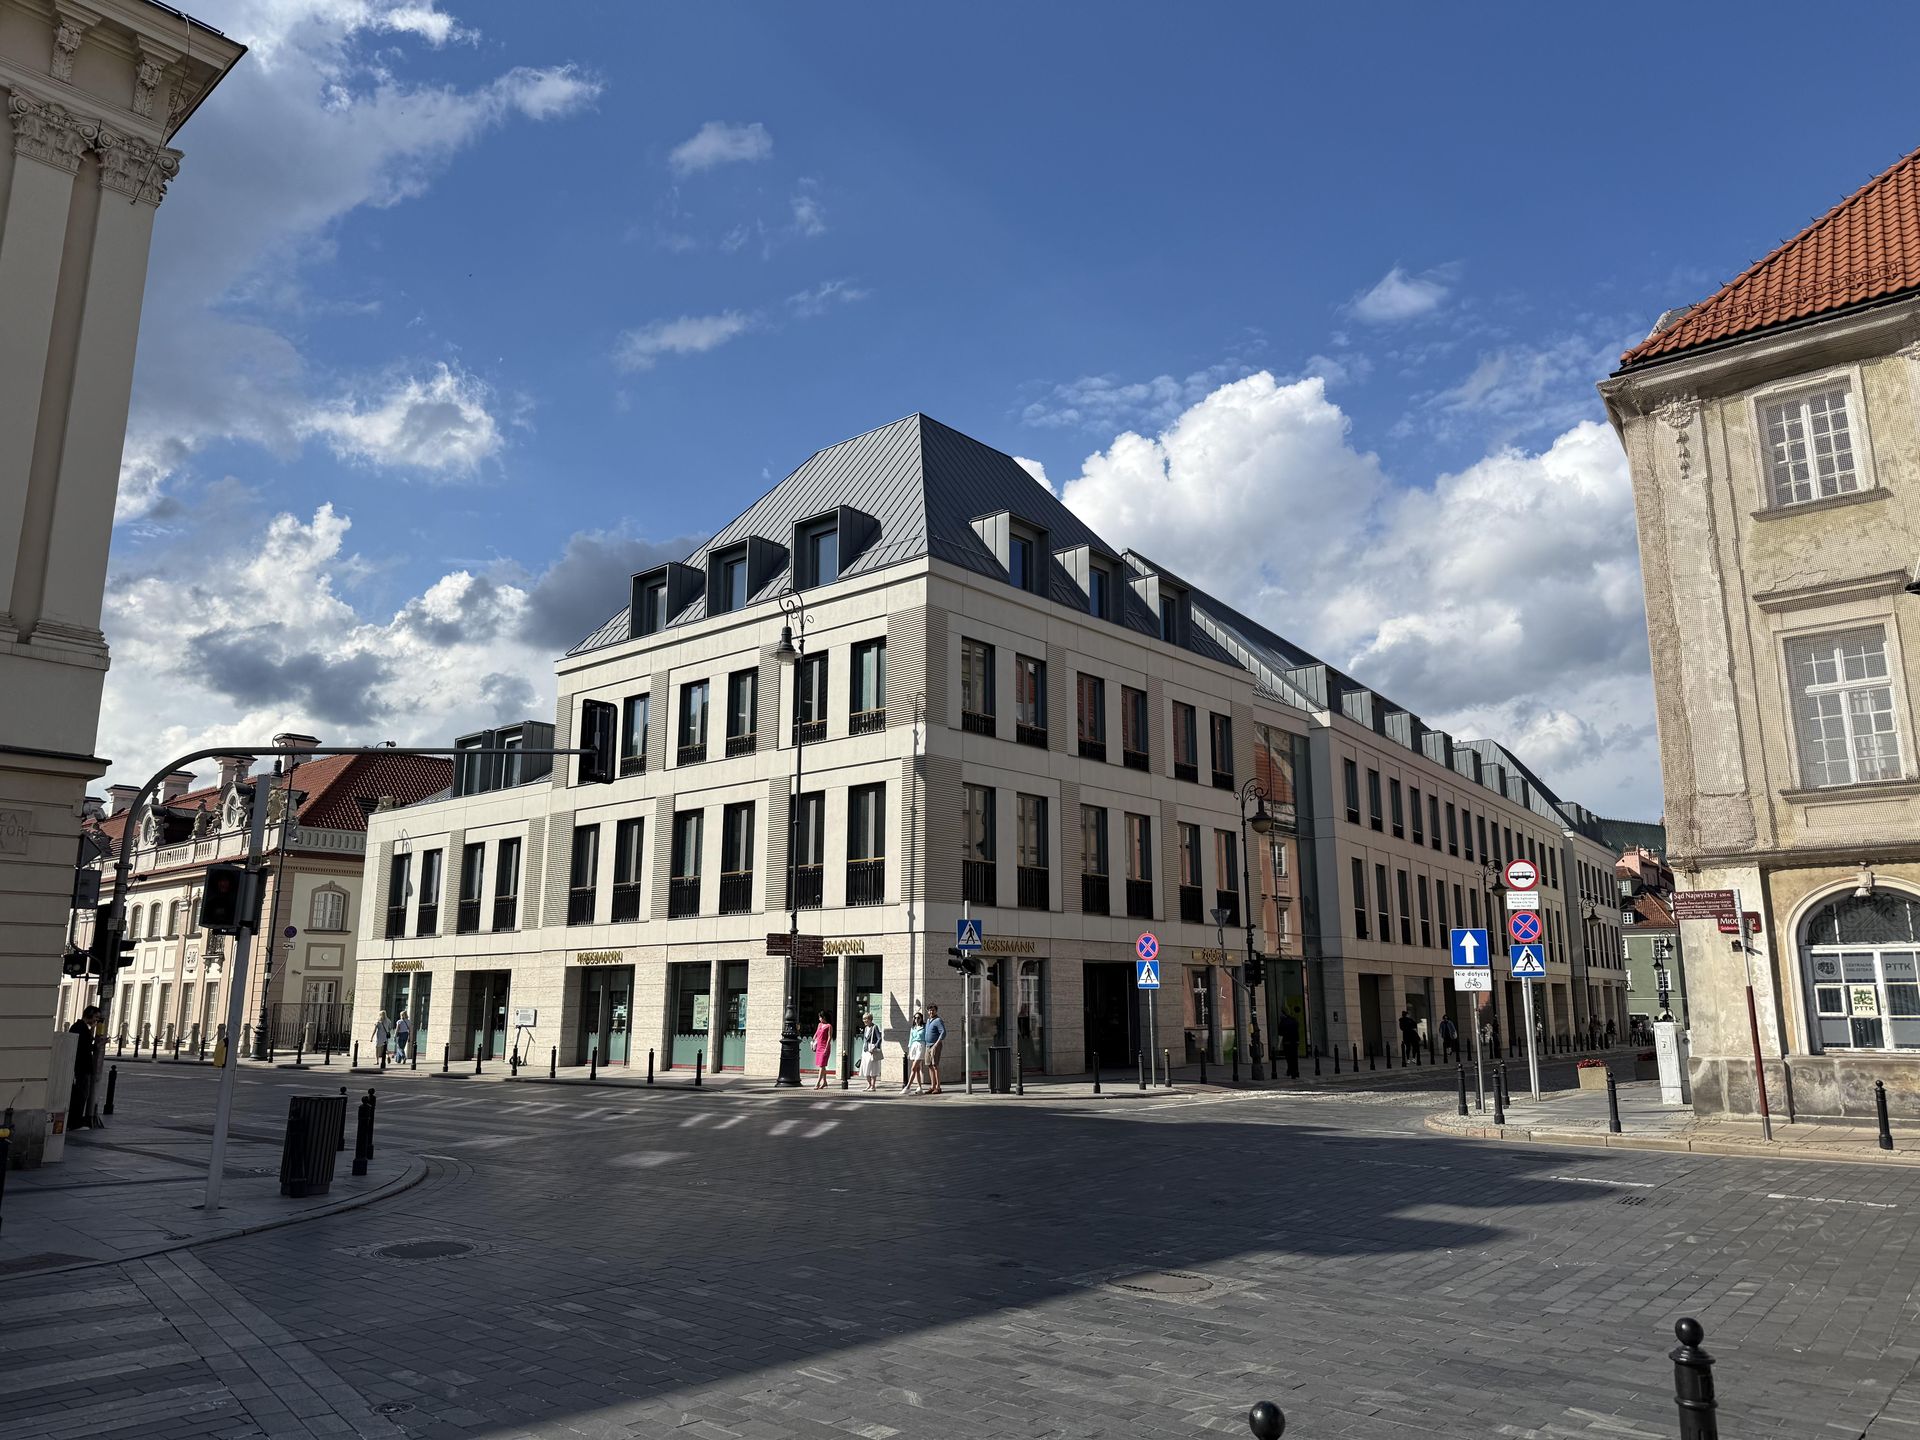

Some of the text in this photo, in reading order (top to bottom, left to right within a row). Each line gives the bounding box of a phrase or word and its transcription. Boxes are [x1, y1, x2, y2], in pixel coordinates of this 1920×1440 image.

[1685, 892, 1717, 900] Najwyższy
[982, 939, 1035, 953] ROSSMANN
[577, 950, 624, 965] ROSSMANN
[1885, 962, 1912, 971] PTTK
